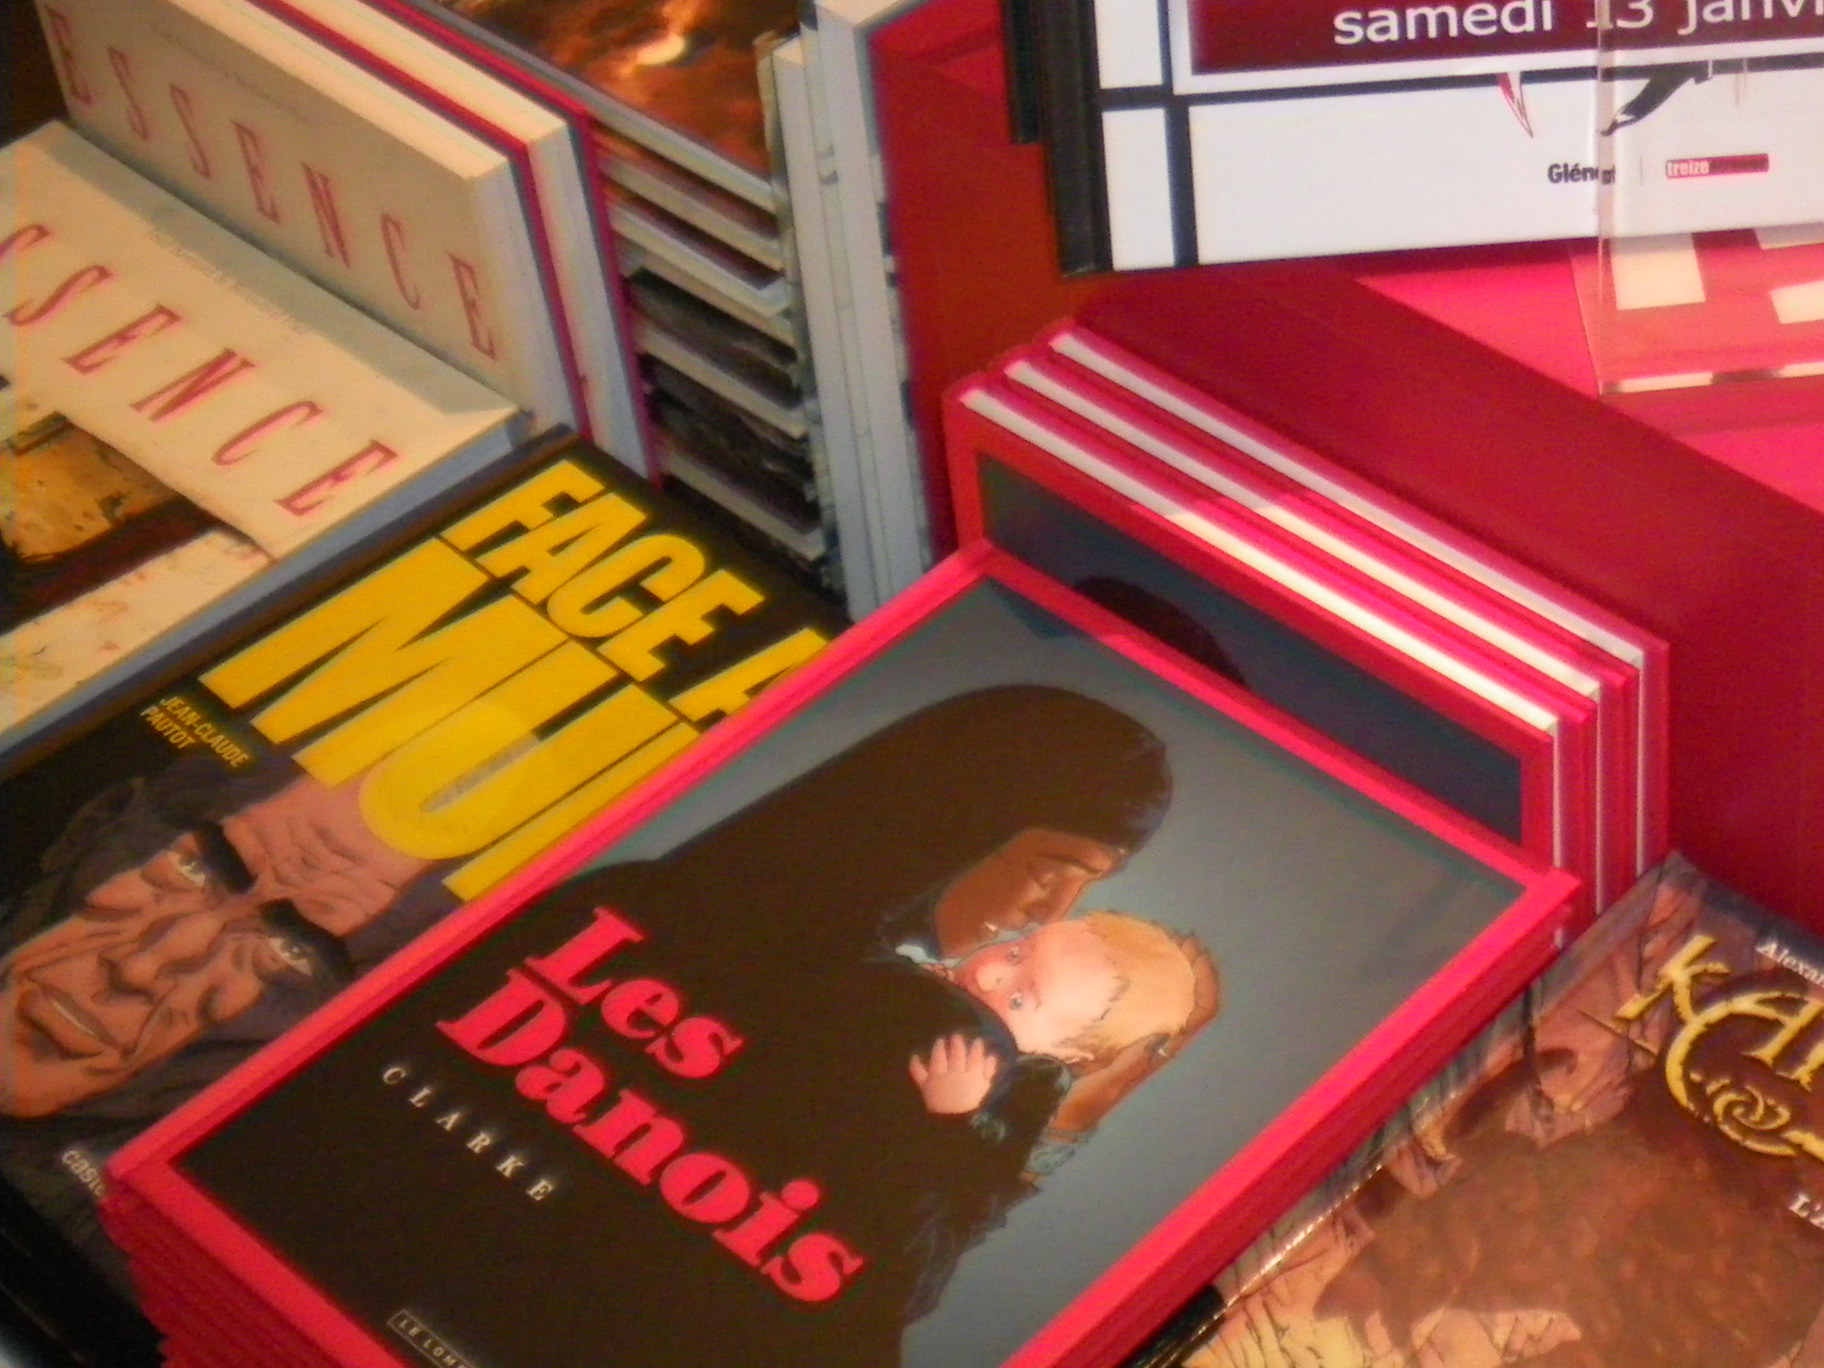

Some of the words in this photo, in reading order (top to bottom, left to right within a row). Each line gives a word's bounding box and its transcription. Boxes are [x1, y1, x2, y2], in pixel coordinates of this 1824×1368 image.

[44, 3, 497, 361] ESSENCE
[0, 223, 400, 519] SENCE
[440, 459, 764, 683] FACE
[666, 628, 829, 723] A
[138, 707, 195, 754] PAUTOT
[159, 694, 250, 769] JEAN-CLAUDE
[199, 537, 700, 902] MU
[525, 905, 741, 1080] Les
[380, 1063, 556, 1205] CLARKE
[436, 966, 866, 1304] Danois
[398, 1317, 421, 1339] LE
